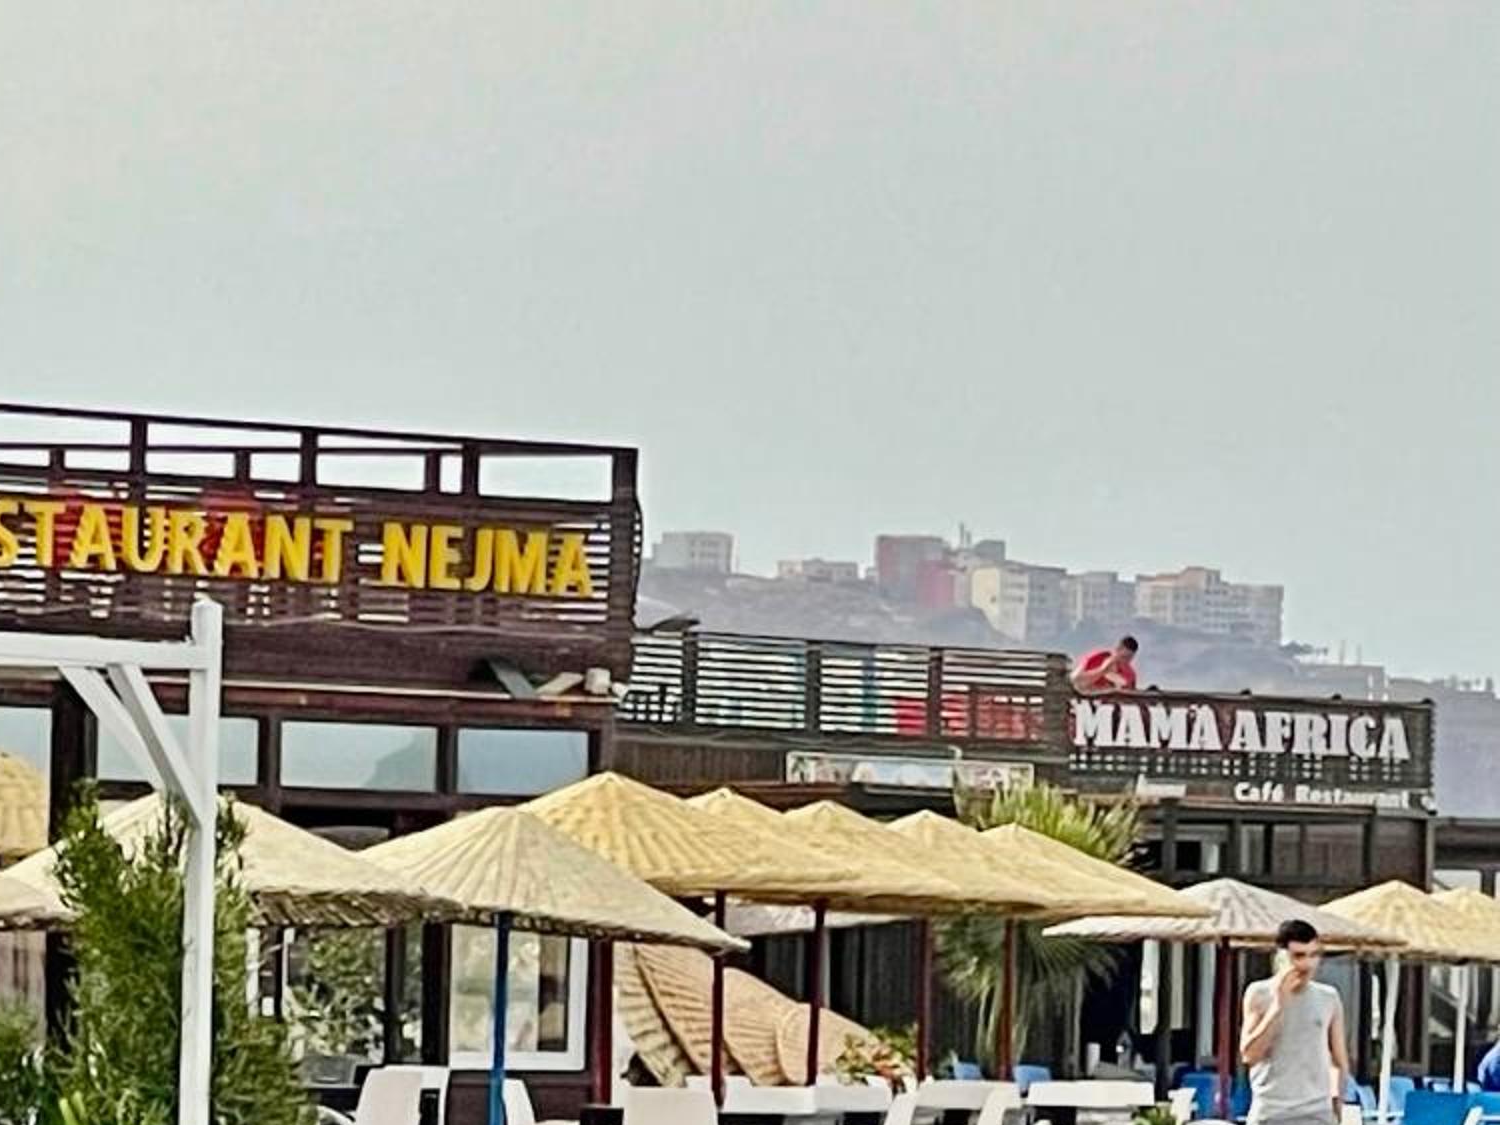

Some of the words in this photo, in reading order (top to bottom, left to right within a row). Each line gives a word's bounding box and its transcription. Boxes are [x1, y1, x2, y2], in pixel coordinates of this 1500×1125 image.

[380, 522, 595, 599] NEJMA
[1070, 699, 1222, 750] MAMA
[1228, 710, 1410, 761] AFRICA
